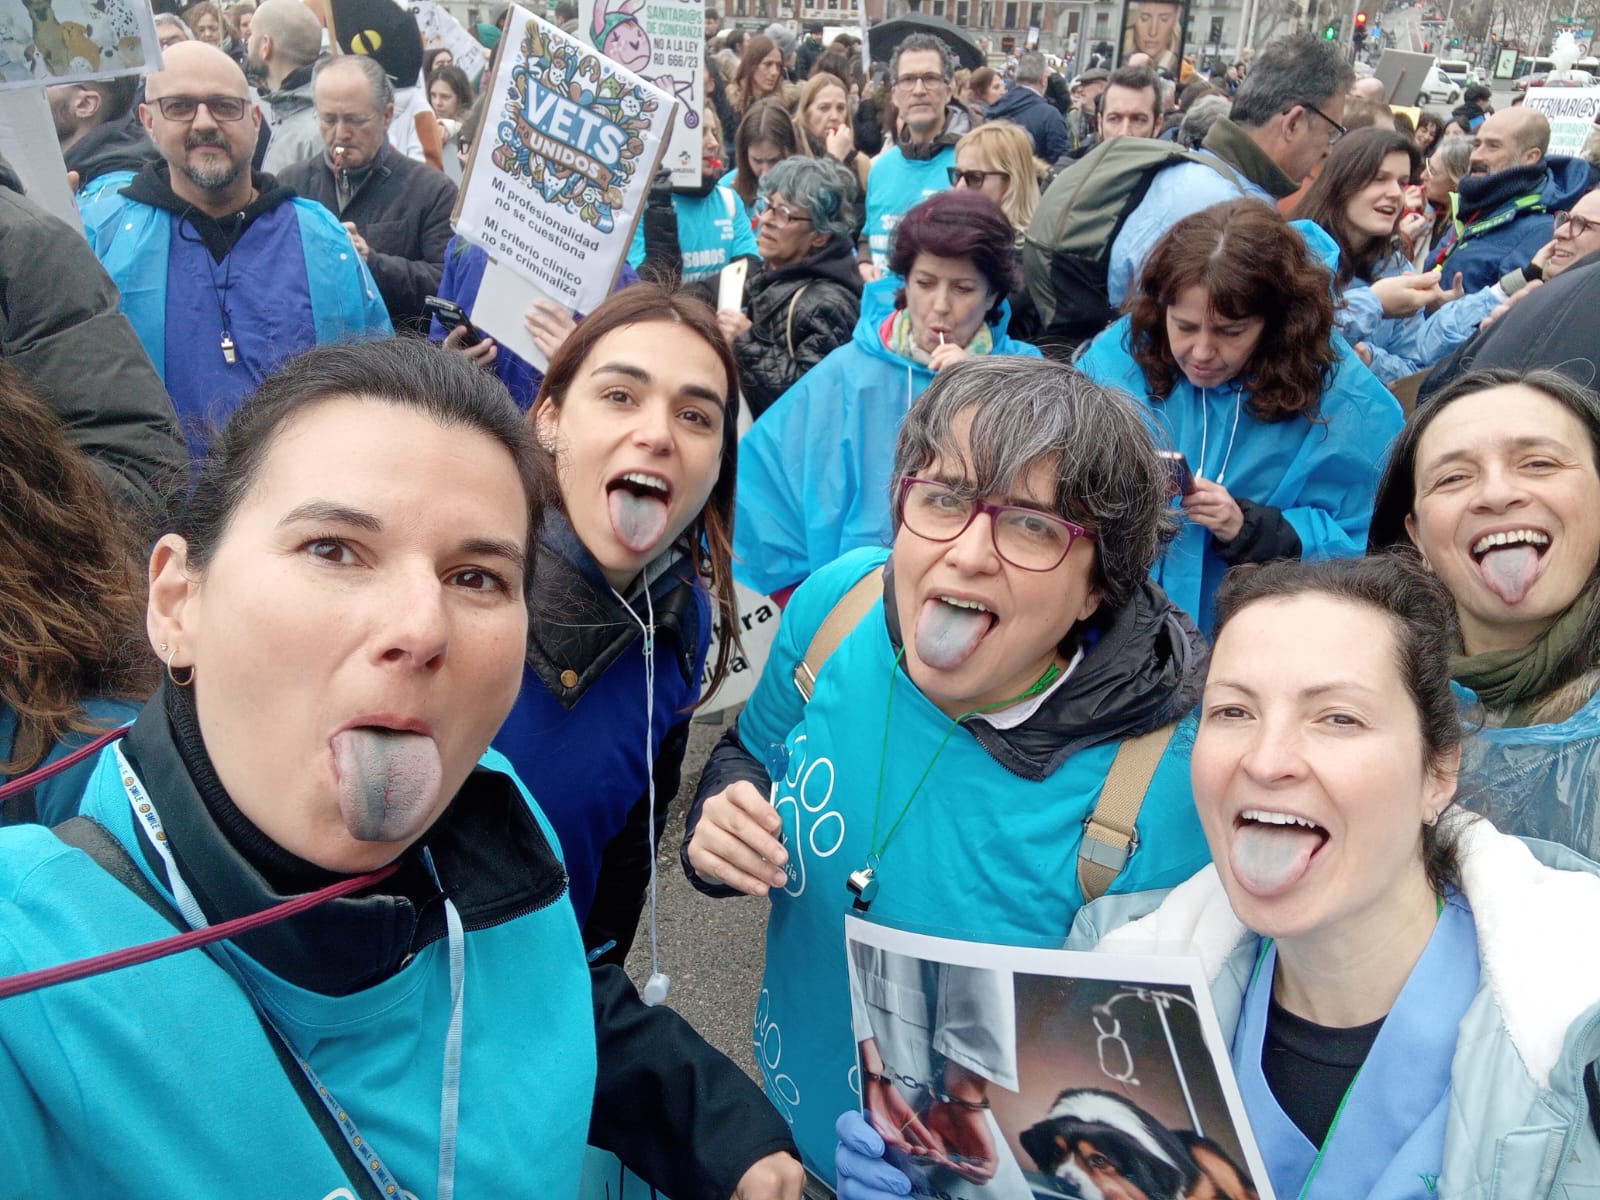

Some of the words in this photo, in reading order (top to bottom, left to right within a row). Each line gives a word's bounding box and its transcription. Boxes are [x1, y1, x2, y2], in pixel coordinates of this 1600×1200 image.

[646, 5, 703, 24] SANITARI@S
[646, 22, 658, 34] DE
[660, 23, 702, 38] CONFIANZA
[653, 38, 664, 50] NO
[666, 39, 671, 51] A
[673, 40, 683, 52] LA
[684, 41, 699, 53] LEY
[653, 52, 665, 65] RD
[668, 54, 699, 68] 666/23
[529, 132, 600, 178] UNIDOS
[491, 177, 505, 193] Mi
[507, 189, 600, 252] profesionalidad
[495, 196, 511, 212] no
[513, 208, 526, 222] se
[528, 220, 586, 261] cuestiona
[484, 216, 499, 232] Mi
[501, 227, 540, 260] criterio
[481, 231, 497, 246] no
[499, 242, 513, 256] se
[515, 253, 578, 297] criminaliza
